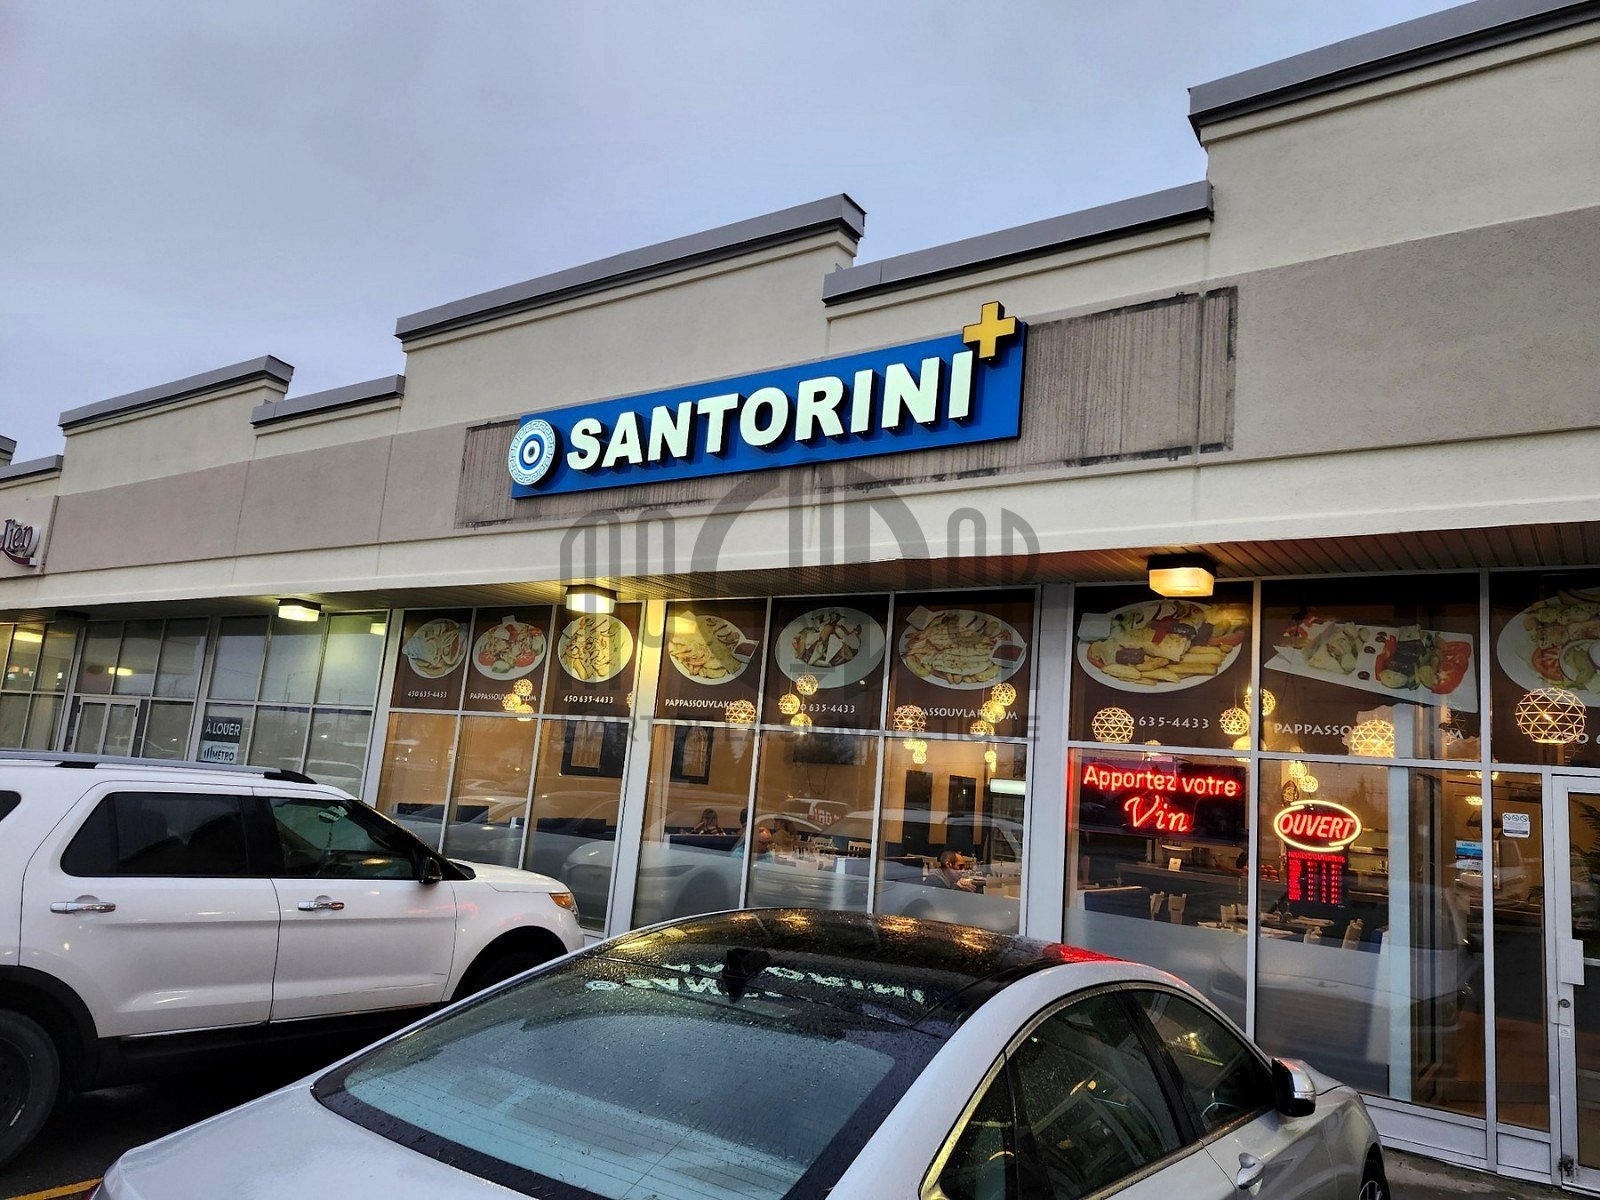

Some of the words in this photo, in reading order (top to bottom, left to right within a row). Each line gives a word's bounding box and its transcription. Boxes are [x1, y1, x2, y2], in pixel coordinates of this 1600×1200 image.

[566, 349, 974, 472] SANTORINI
[419, 690, 448, 699] 635-4433
[563, 695, 578, 704] 450
[578, 695, 614, 705] 635-4433
[808, 703, 856, 714] 635-4433
[212, 722, 241, 736] LOUER
[1138, 715, 1210, 729] 635-4433
[1082, 765, 1177, 793] Apportez
[1181, 775, 1238, 798] votre
[1123, 794, 1190, 833] Vin
[1280, 813, 1356, 840] OUVERT
